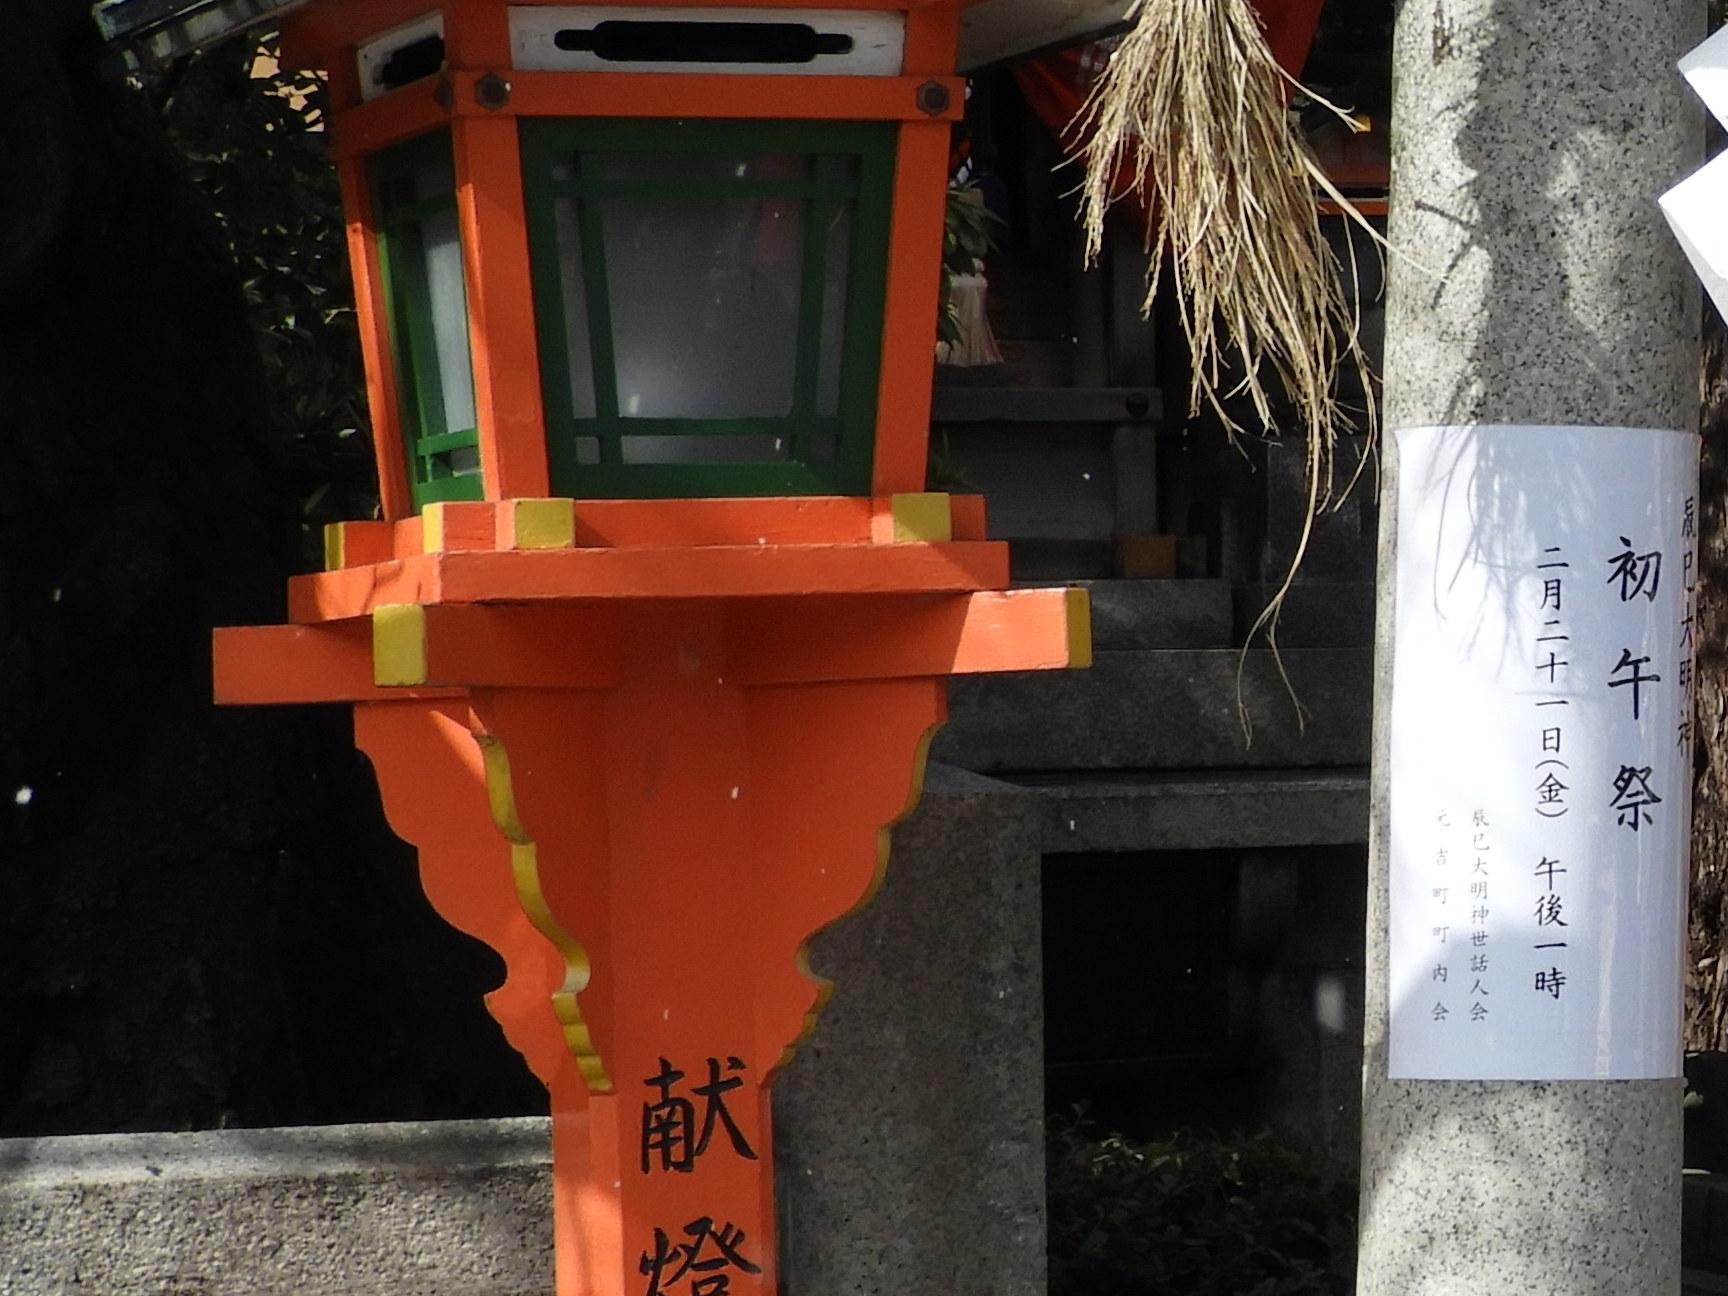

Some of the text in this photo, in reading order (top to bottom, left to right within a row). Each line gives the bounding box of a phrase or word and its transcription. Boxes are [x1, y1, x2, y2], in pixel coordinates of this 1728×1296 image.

[1605, 534, 1664, 832] 初午祭
[1533, 856, 1569, 1001] 午後一時
